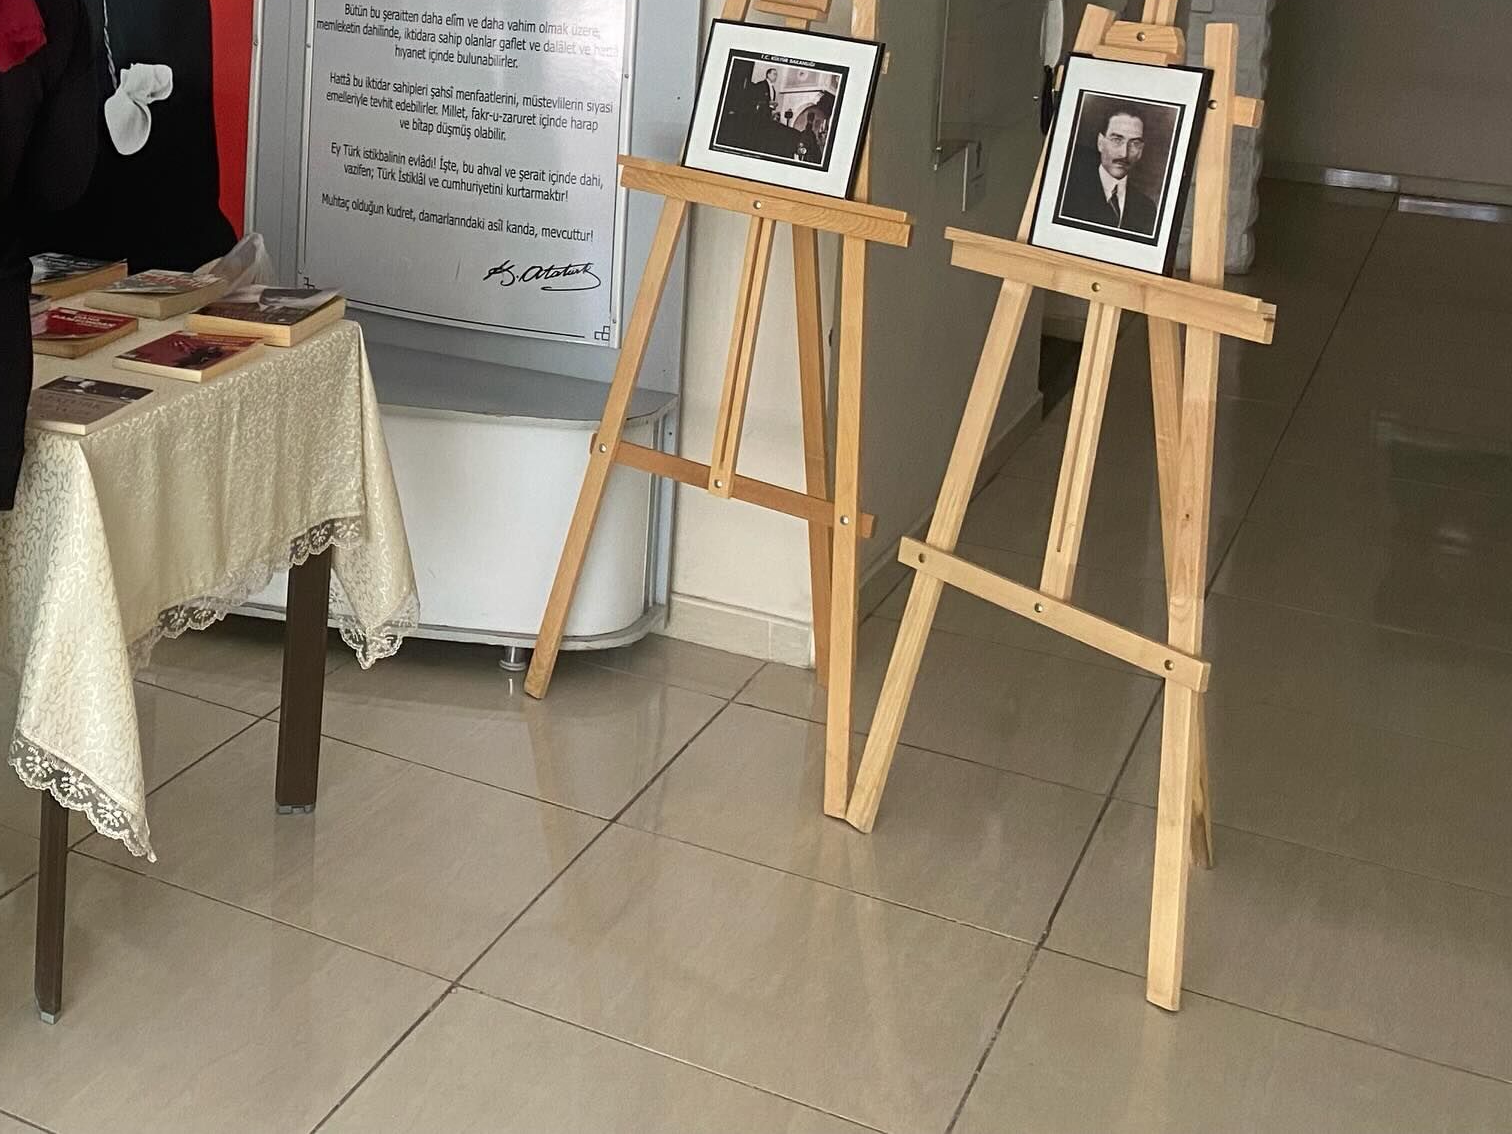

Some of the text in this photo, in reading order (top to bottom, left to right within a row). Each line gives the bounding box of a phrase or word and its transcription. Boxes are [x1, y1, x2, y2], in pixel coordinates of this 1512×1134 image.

[395, 44, 426, 60] hıyanet
[428, 49, 455, 63] içinde
[329, 72, 351, 86] Hattâ
[352, 75, 363, 87] bu
[365, 76, 390, 90] iktidar
[392, 82, 428, 96] sahipleri
[455, 89, 520, 106] menfaatlerini,
[326, 91, 368, 107] emelleriyle
[369, 95, 393, 109] tevhit
[441, 104, 469, 121] Millet,
[471, 107, 536, 125] fakr-u-zaruret
[538, 114, 567, 129] içinde
[570, 116, 599, 133] harap
[400, 120, 410, 129] ve
[436, 122, 471, 140] düşmüş
[473, 126, 508, 141] olabilir.
[331, 142, 341, 157] Ey
[343, 144, 361, 158] Türk
[362, 147, 406, 165] istikbalinin
[439, 156, 459, 173] İşte,
[462, 161, 475, 174] bu
[476, 163, 502, 176] ahval
[504, 169, 516, 178] ve
[518, 170, 545, 181] şerait
[548, 170, 577, 184] içinde
[579, 173, 605, 189] dahi,
[378, 167, 396, 181] Türk
[397, 170, 426, 185] İstiklâl
[428, 178, 439, 187] ve
[440, 179, 504, 195] cumhuriyetini
[505, 184, 571, 201] kurtarmaktır!
[322, 193, 350, 211] Muhtaç
[351, 199, 384, 215] olduğun
[386, 204, 416, 221] kudret,
[505, 220, 537, 237] kanda,
[540, 228, 596, 242] mevcuttur!
